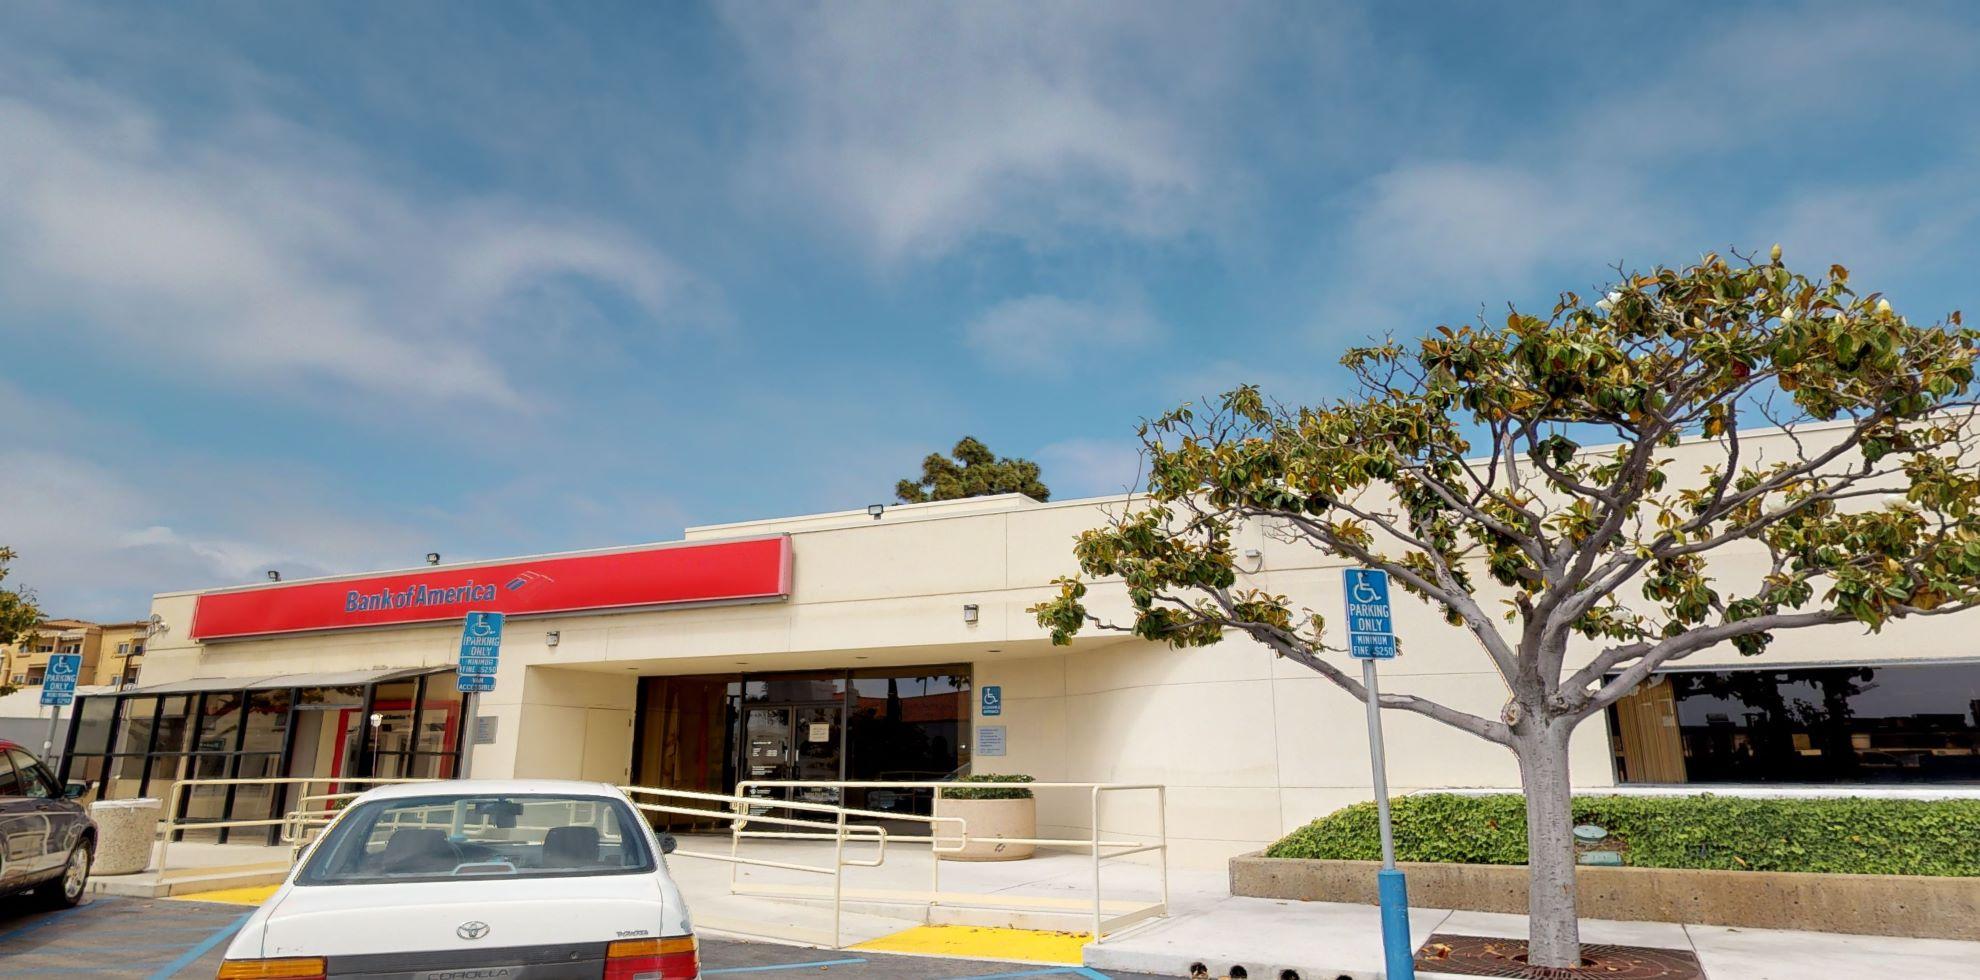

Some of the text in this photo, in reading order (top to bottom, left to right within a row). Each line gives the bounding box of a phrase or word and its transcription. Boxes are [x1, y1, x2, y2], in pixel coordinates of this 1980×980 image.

[345, 580, 497, 612] Bank of America
[1350, 603, 1389, 618] PARKING
[1359, 618, 1383, 632] ONLY
[463, 636, 500, 647] PARKING
[1357, 634, 1388, 645] MINIMUM
[470, 646, 493, 656] ONLY
[1353, 645, 1394, 656] FINE $250
[46, 674, 77, 682] PARKING
[50, 682, 69, 690] ONLY
[427, 969, 510, 980] COROLLA
